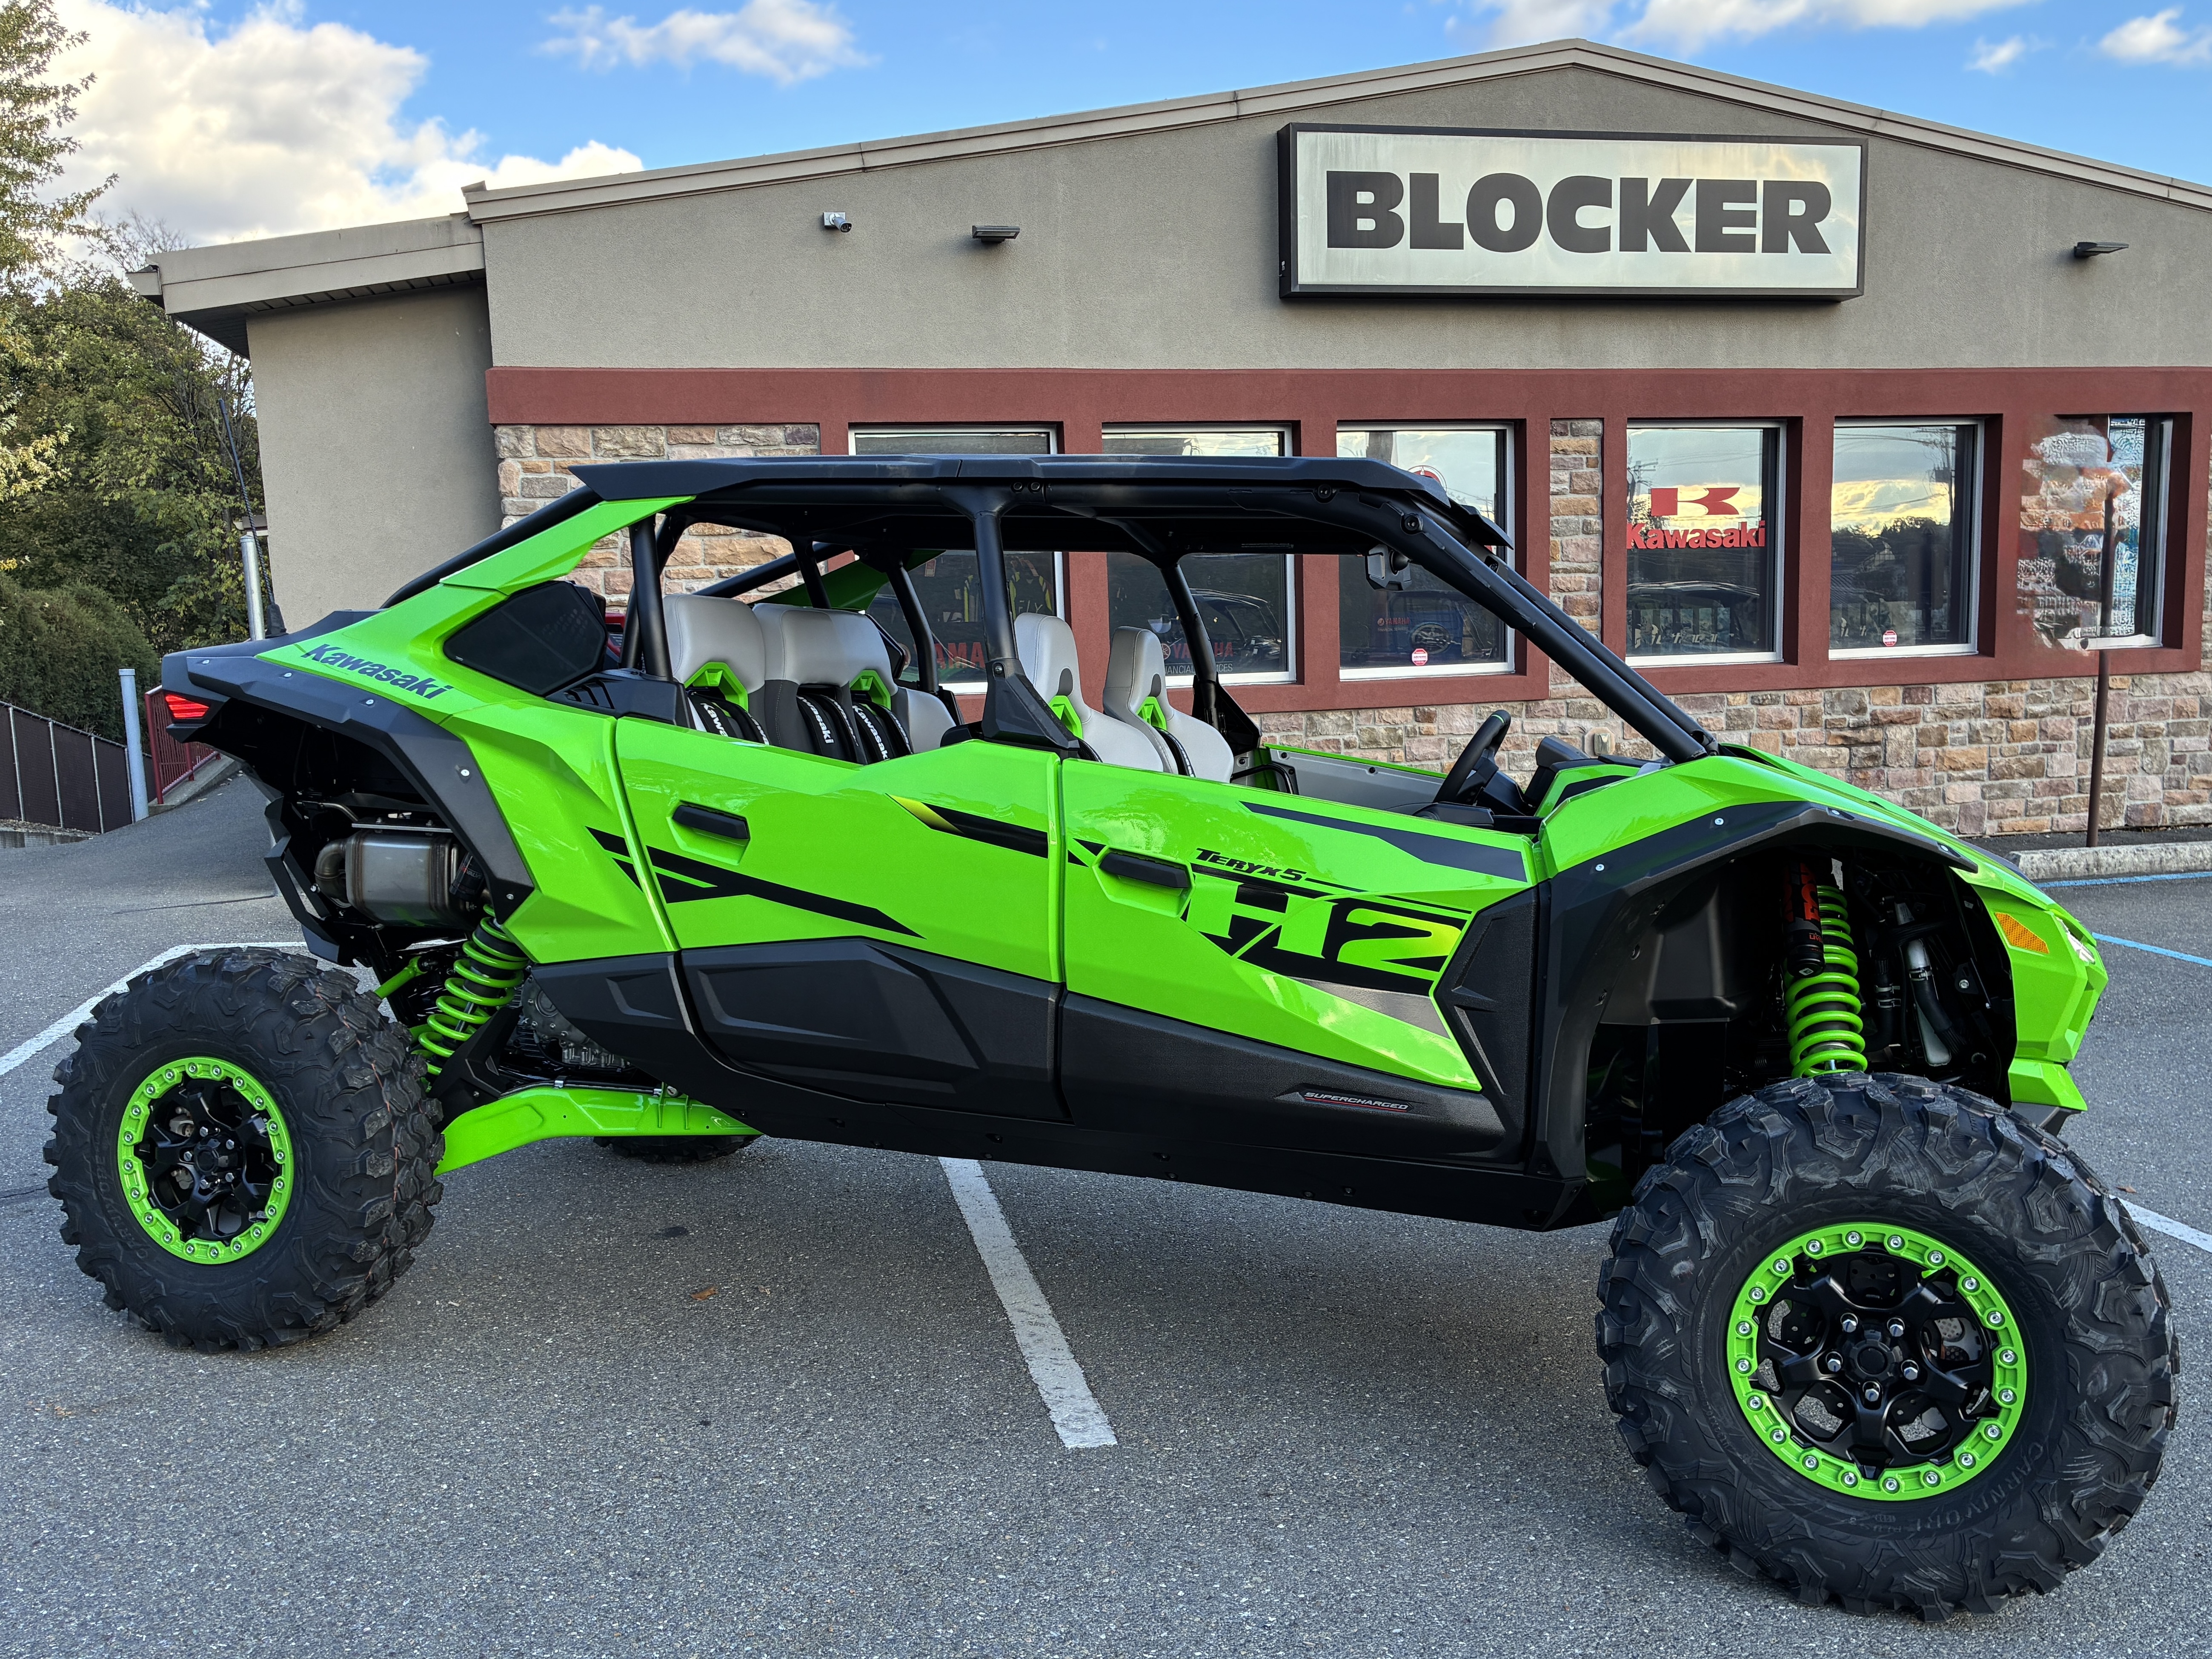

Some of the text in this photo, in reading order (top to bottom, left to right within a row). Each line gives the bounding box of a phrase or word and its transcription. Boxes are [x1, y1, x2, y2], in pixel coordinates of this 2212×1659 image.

[1326, 170, 1832, 254] BLOCKER
[1626, 520, 1766, 550] Kawasaki
[934, 642, 986, 669] AMA
[1173, 641, 1233, 660] YAHA
[301, 644, 454, 699] Kawasaki
[1165, 663, 1233, 675] ANCIAL ICES
[852, 705, 890, 761] Kawasak
[1185, 872, 1462, 974] H2
[1304, 1092, 1409, 1110] SUPERCHARGED
